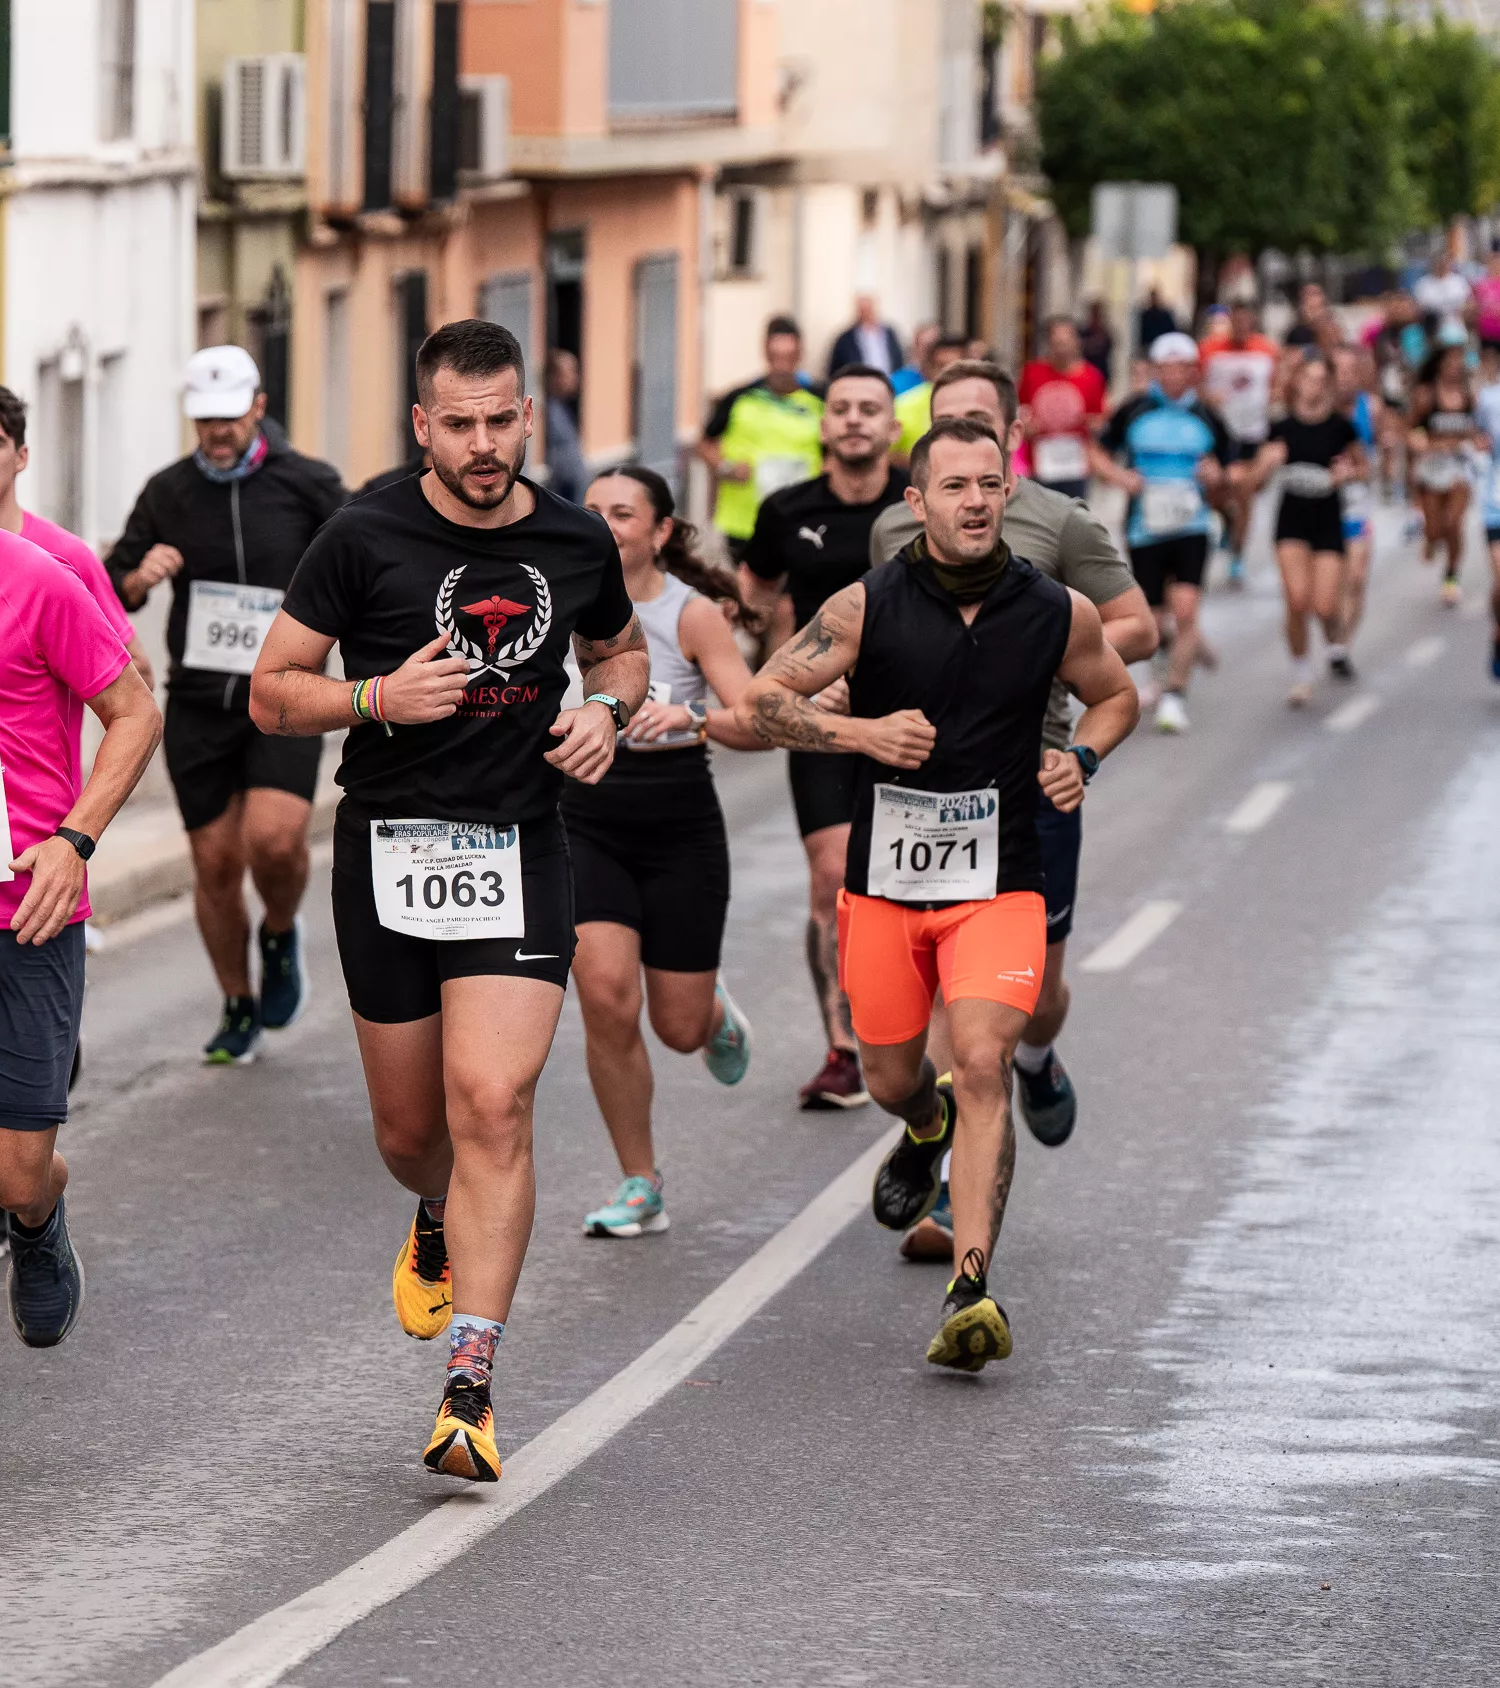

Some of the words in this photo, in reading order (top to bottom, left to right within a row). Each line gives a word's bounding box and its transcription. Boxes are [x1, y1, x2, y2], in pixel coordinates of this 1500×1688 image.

[208, 621, 258, 650] 996
[939, 794, 972, 810] 2024
[412, 829, 449, 837] POPULARES
[450, 822, 487, 836] 2024
[889, 838, 978, 872] 1071
[444, 861, 473, 869] IGUALDAD
[395, 870, 505, 910] 1063
